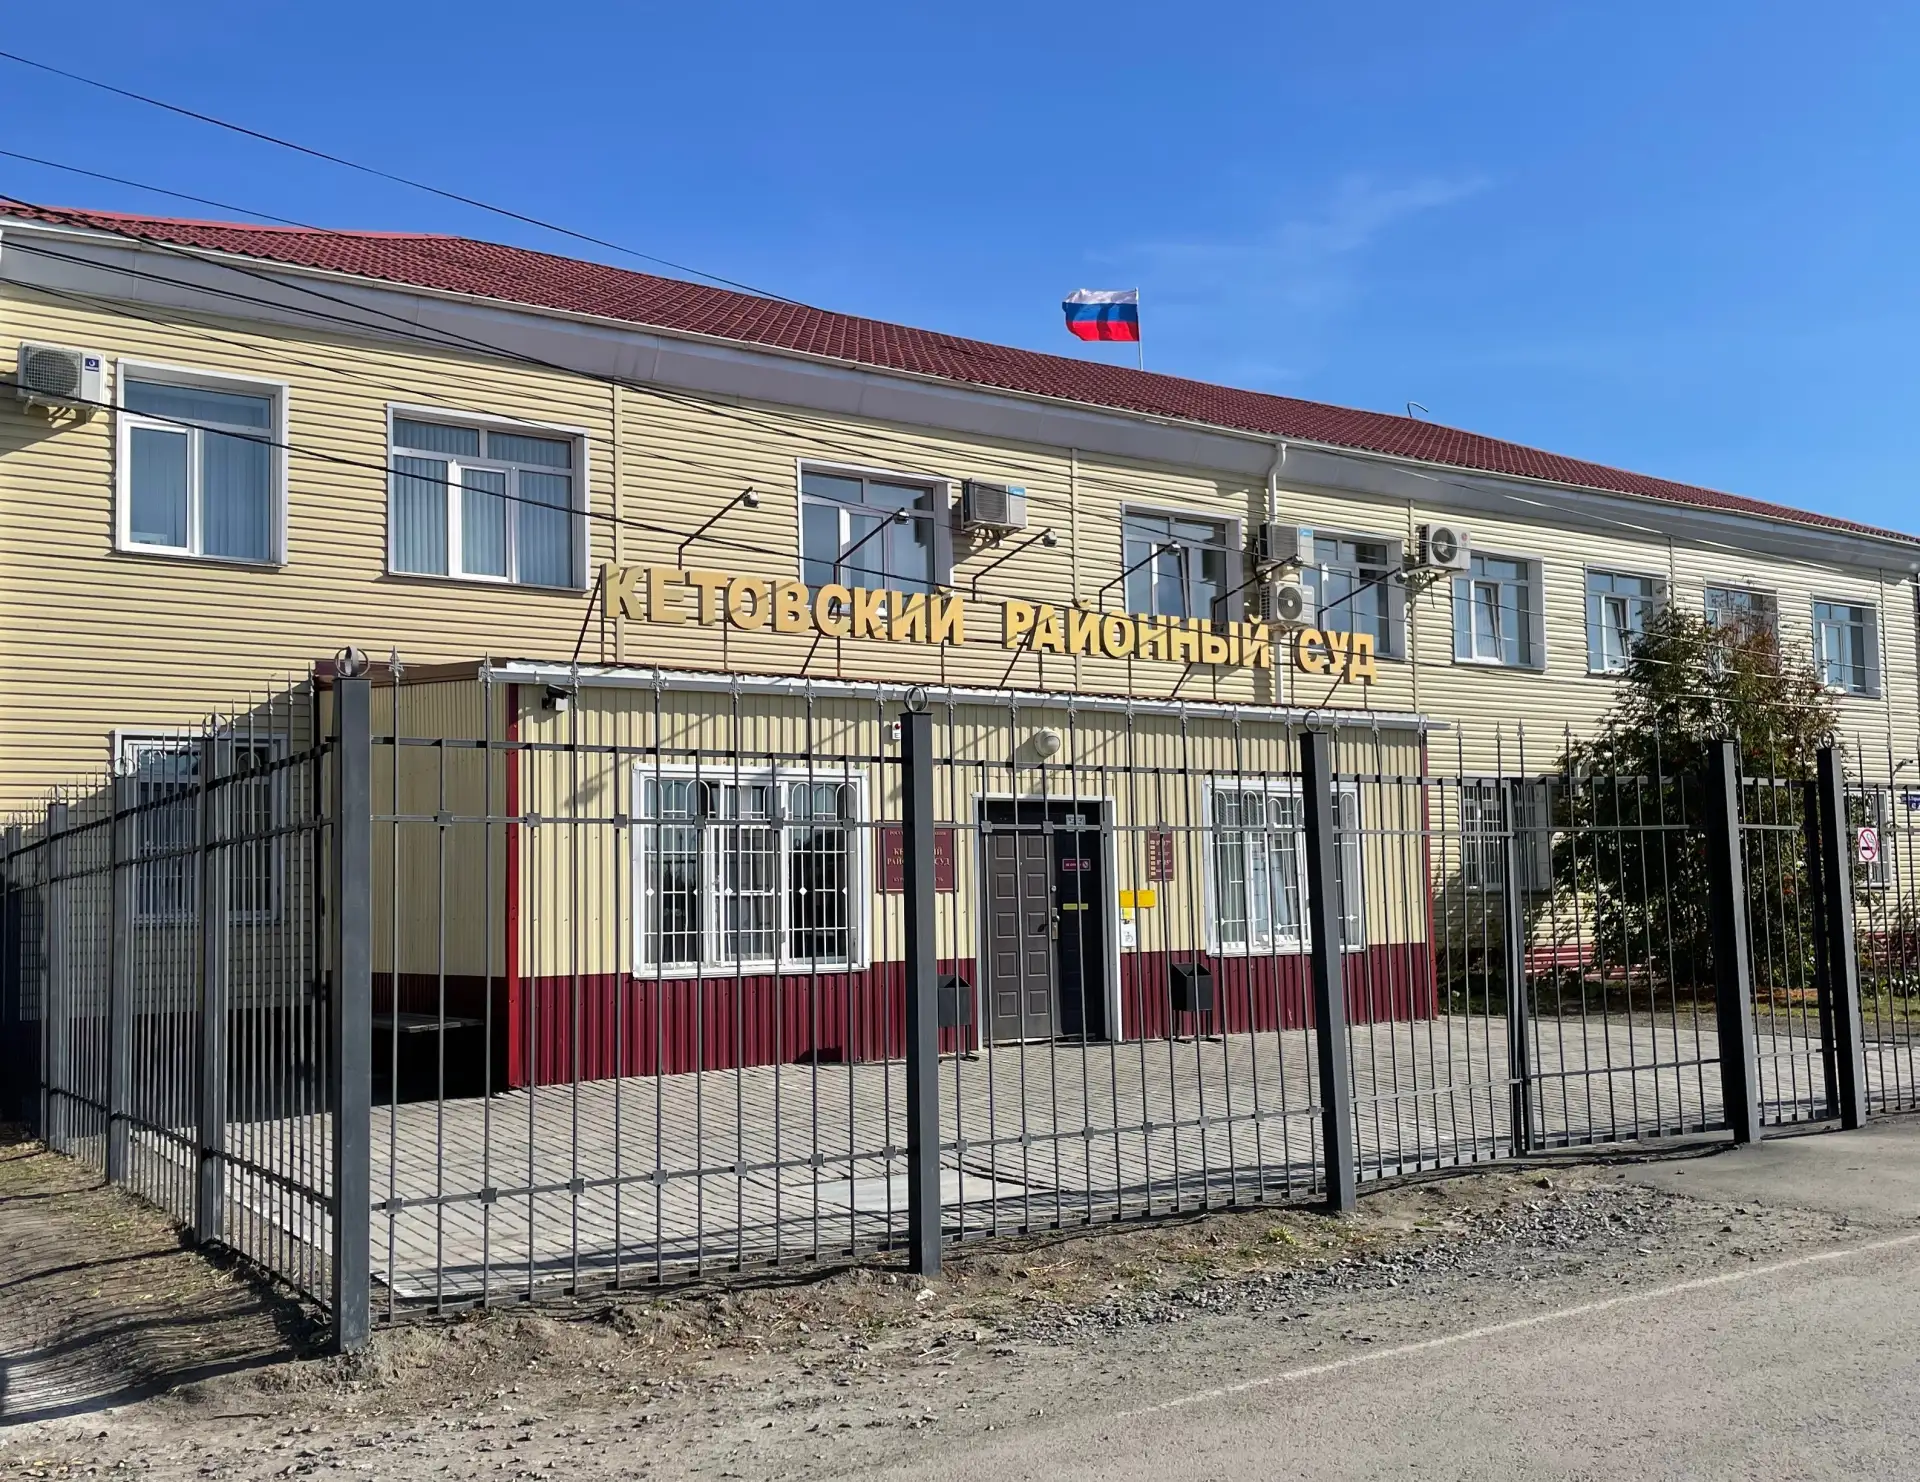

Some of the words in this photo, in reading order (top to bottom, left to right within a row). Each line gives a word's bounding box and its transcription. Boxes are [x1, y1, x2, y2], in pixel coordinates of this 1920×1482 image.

[601, 563, 964, 645] КЕТОВСКИЙ
[1002, 599, 1269, 668] РАЙОННЫЙ
[1295, 628, 1377, 685] СУД
